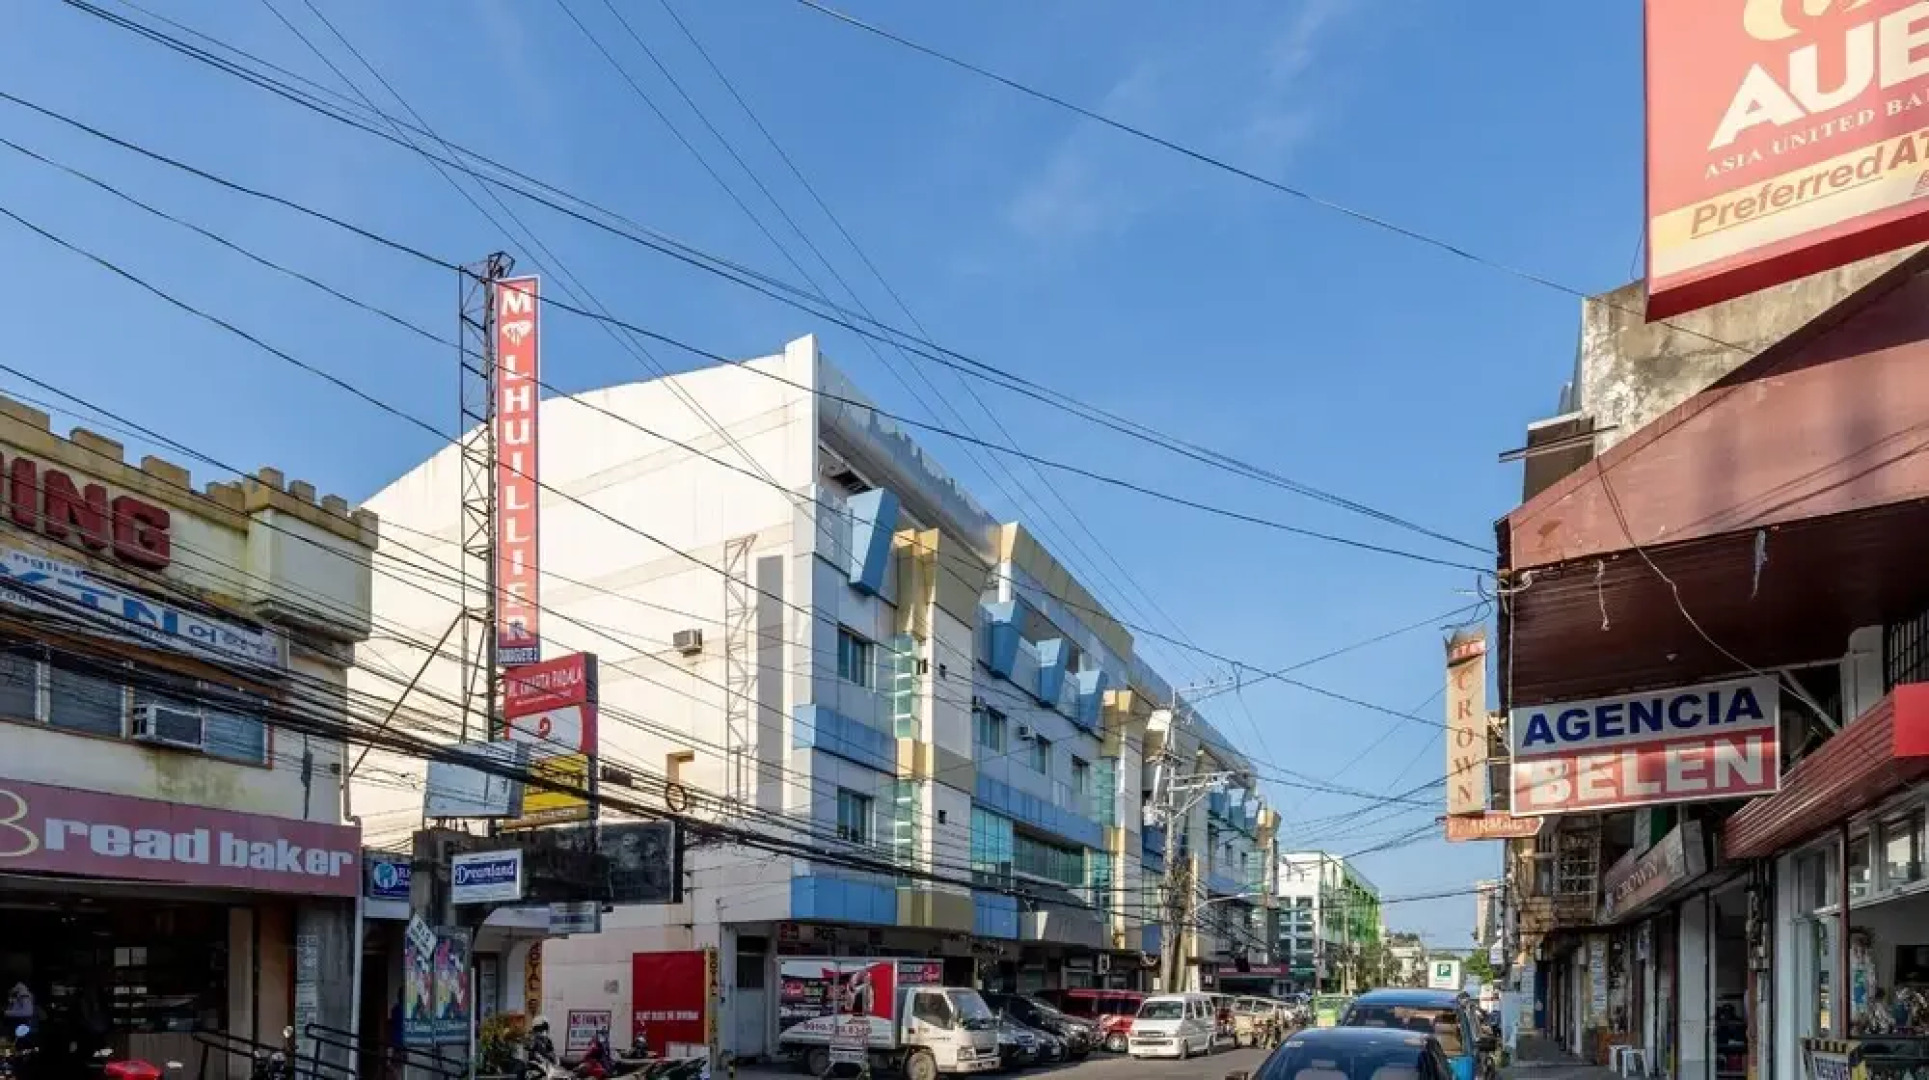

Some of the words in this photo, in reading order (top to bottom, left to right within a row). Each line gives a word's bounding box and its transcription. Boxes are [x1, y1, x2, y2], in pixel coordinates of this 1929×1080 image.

[1704, 149, 1764, 179] ASIA
[1771, 108, 1876, 156] UNITED
[1885, 84, 1929, 117] BA
[1690, 145, 1885, 234] Preferred
[0, 453, 171, 569] ING
[1456, 669, 1477, 804] CROWN
[1521, 686, 1764, 748] AGENCIA
[1529, 735, 1764, 806] BELEN
[0, 788, 210, 865] Bread
[219, 831, 354, 877] baker
